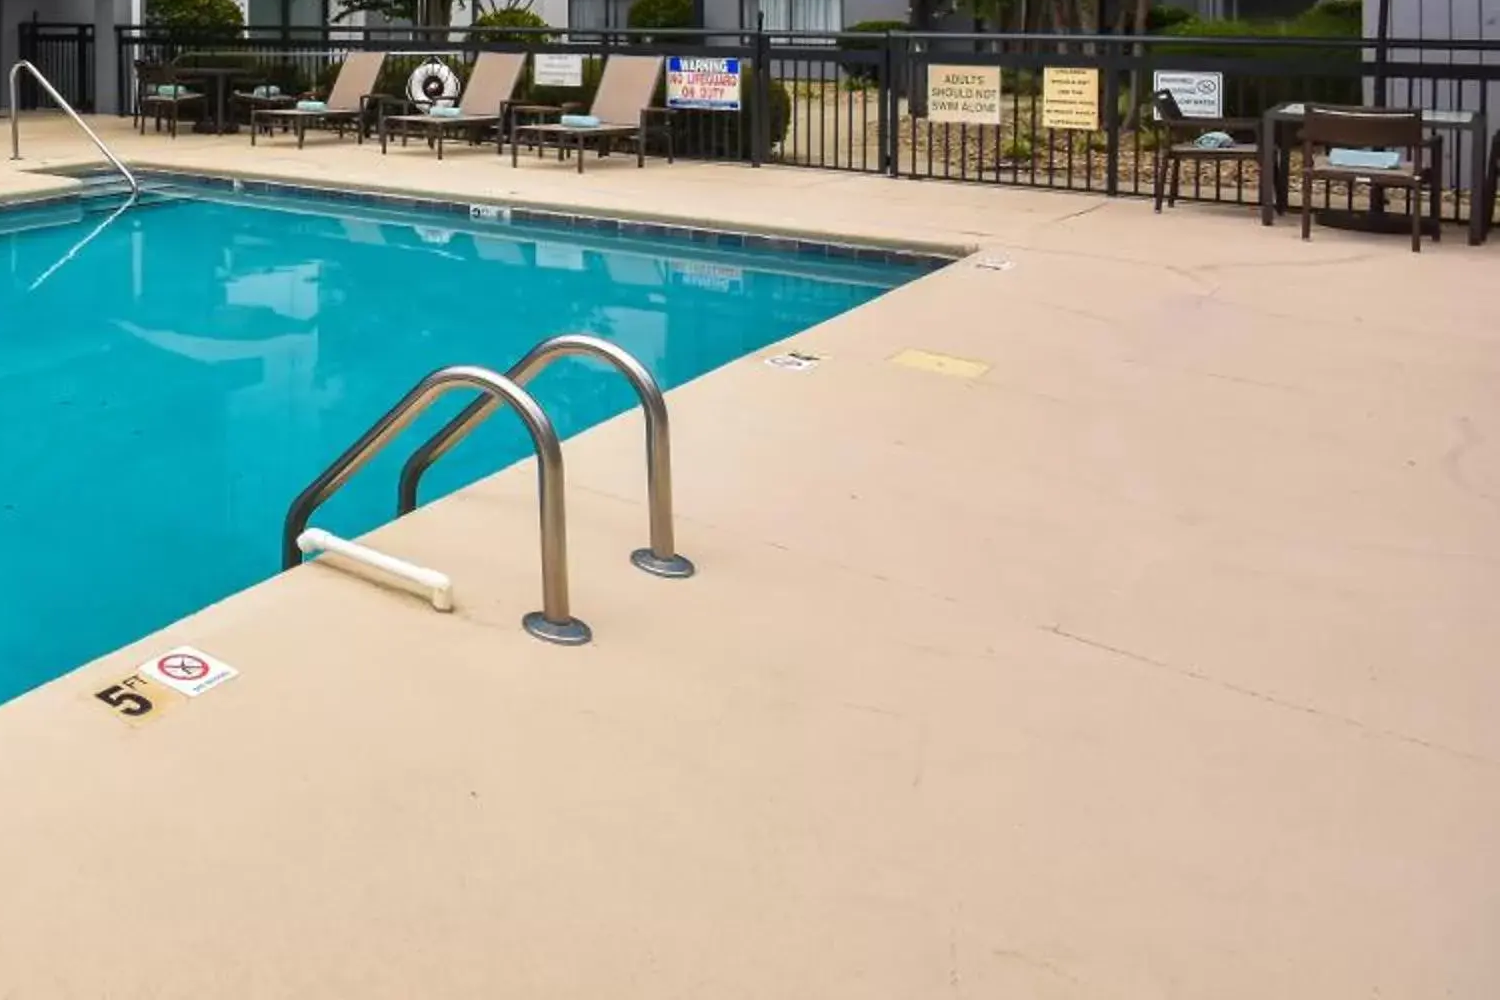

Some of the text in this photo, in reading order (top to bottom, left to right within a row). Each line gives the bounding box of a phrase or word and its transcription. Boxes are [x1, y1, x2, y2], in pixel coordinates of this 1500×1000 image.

[679, 58, 725, 72] WARNING
[669, 73, 737, 87] NO LIFEGUARD
[943, 74, 985, 85] ADULTS
[681, 85, 725, 99] ON DUTY
[931, 87, 997, 100] SHOULD NOT
[931, 101, 997, 113] SWIM ALONE
[122, 675, 148, 690] FT
[94, 685, 153, 716] 5
